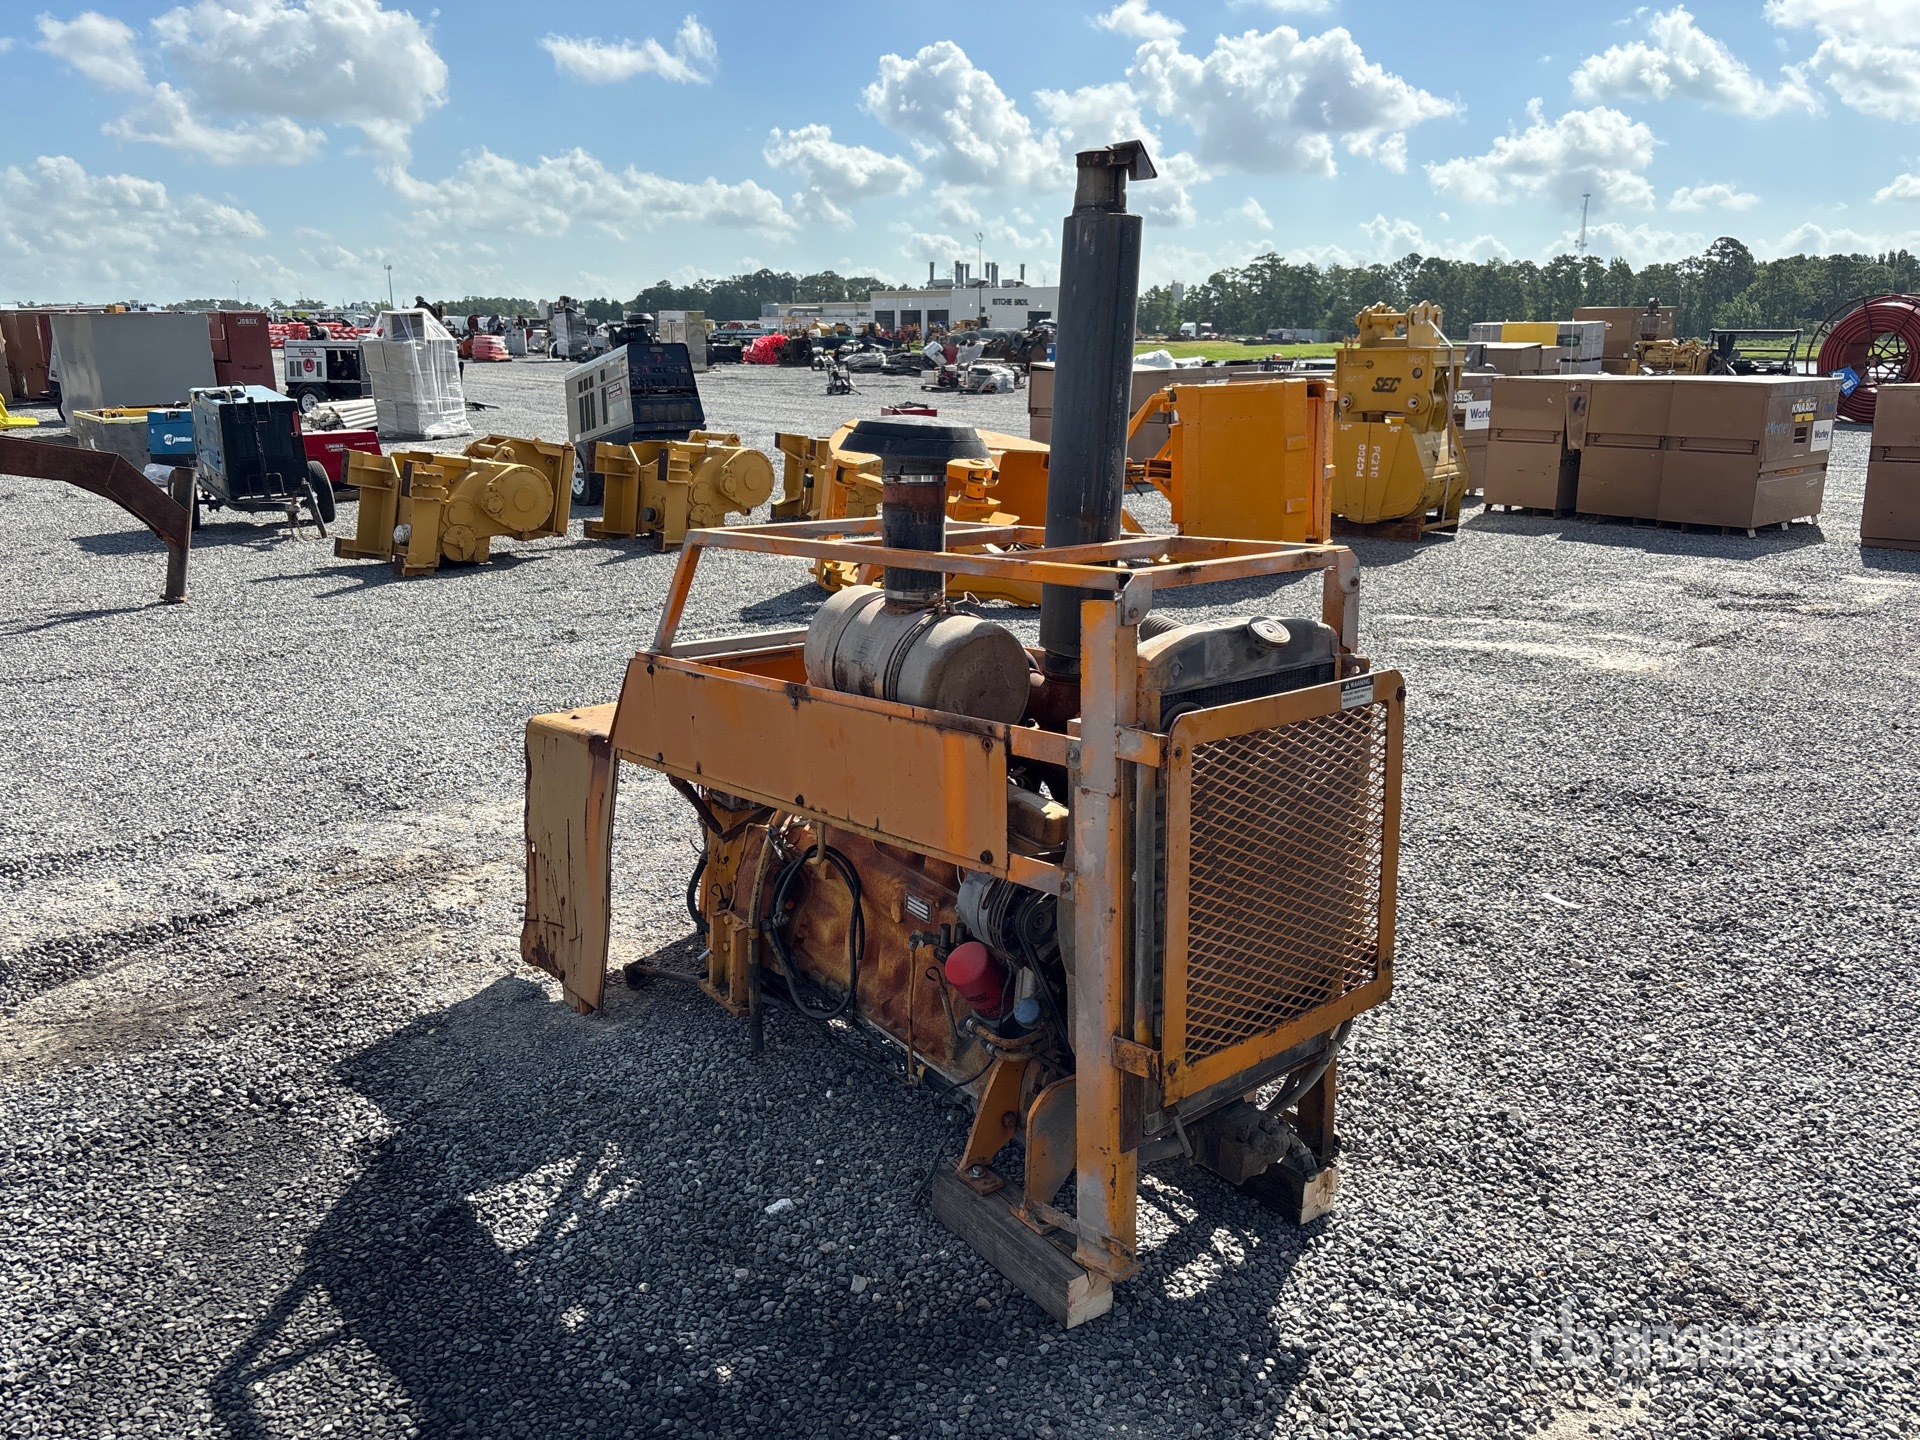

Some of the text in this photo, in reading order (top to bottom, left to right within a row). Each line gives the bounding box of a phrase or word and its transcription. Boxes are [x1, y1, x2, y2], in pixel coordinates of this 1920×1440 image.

[992, 298, 1030, 306] RITCHIE BROS.
[1371, 376, 1402, 393] SEC
[1454, 393, 1474, 403] AACK
[1470, 407, 1491, 419] Worle
[1791, 402, 1818, 414] KNAACK
[1814, 429, 1830, 441] Worley
[1355, 443, 1367, 478] PC200
[1370, 445, 1381, 478] PC210
[1350, 677, 1371, 688] WARNING
